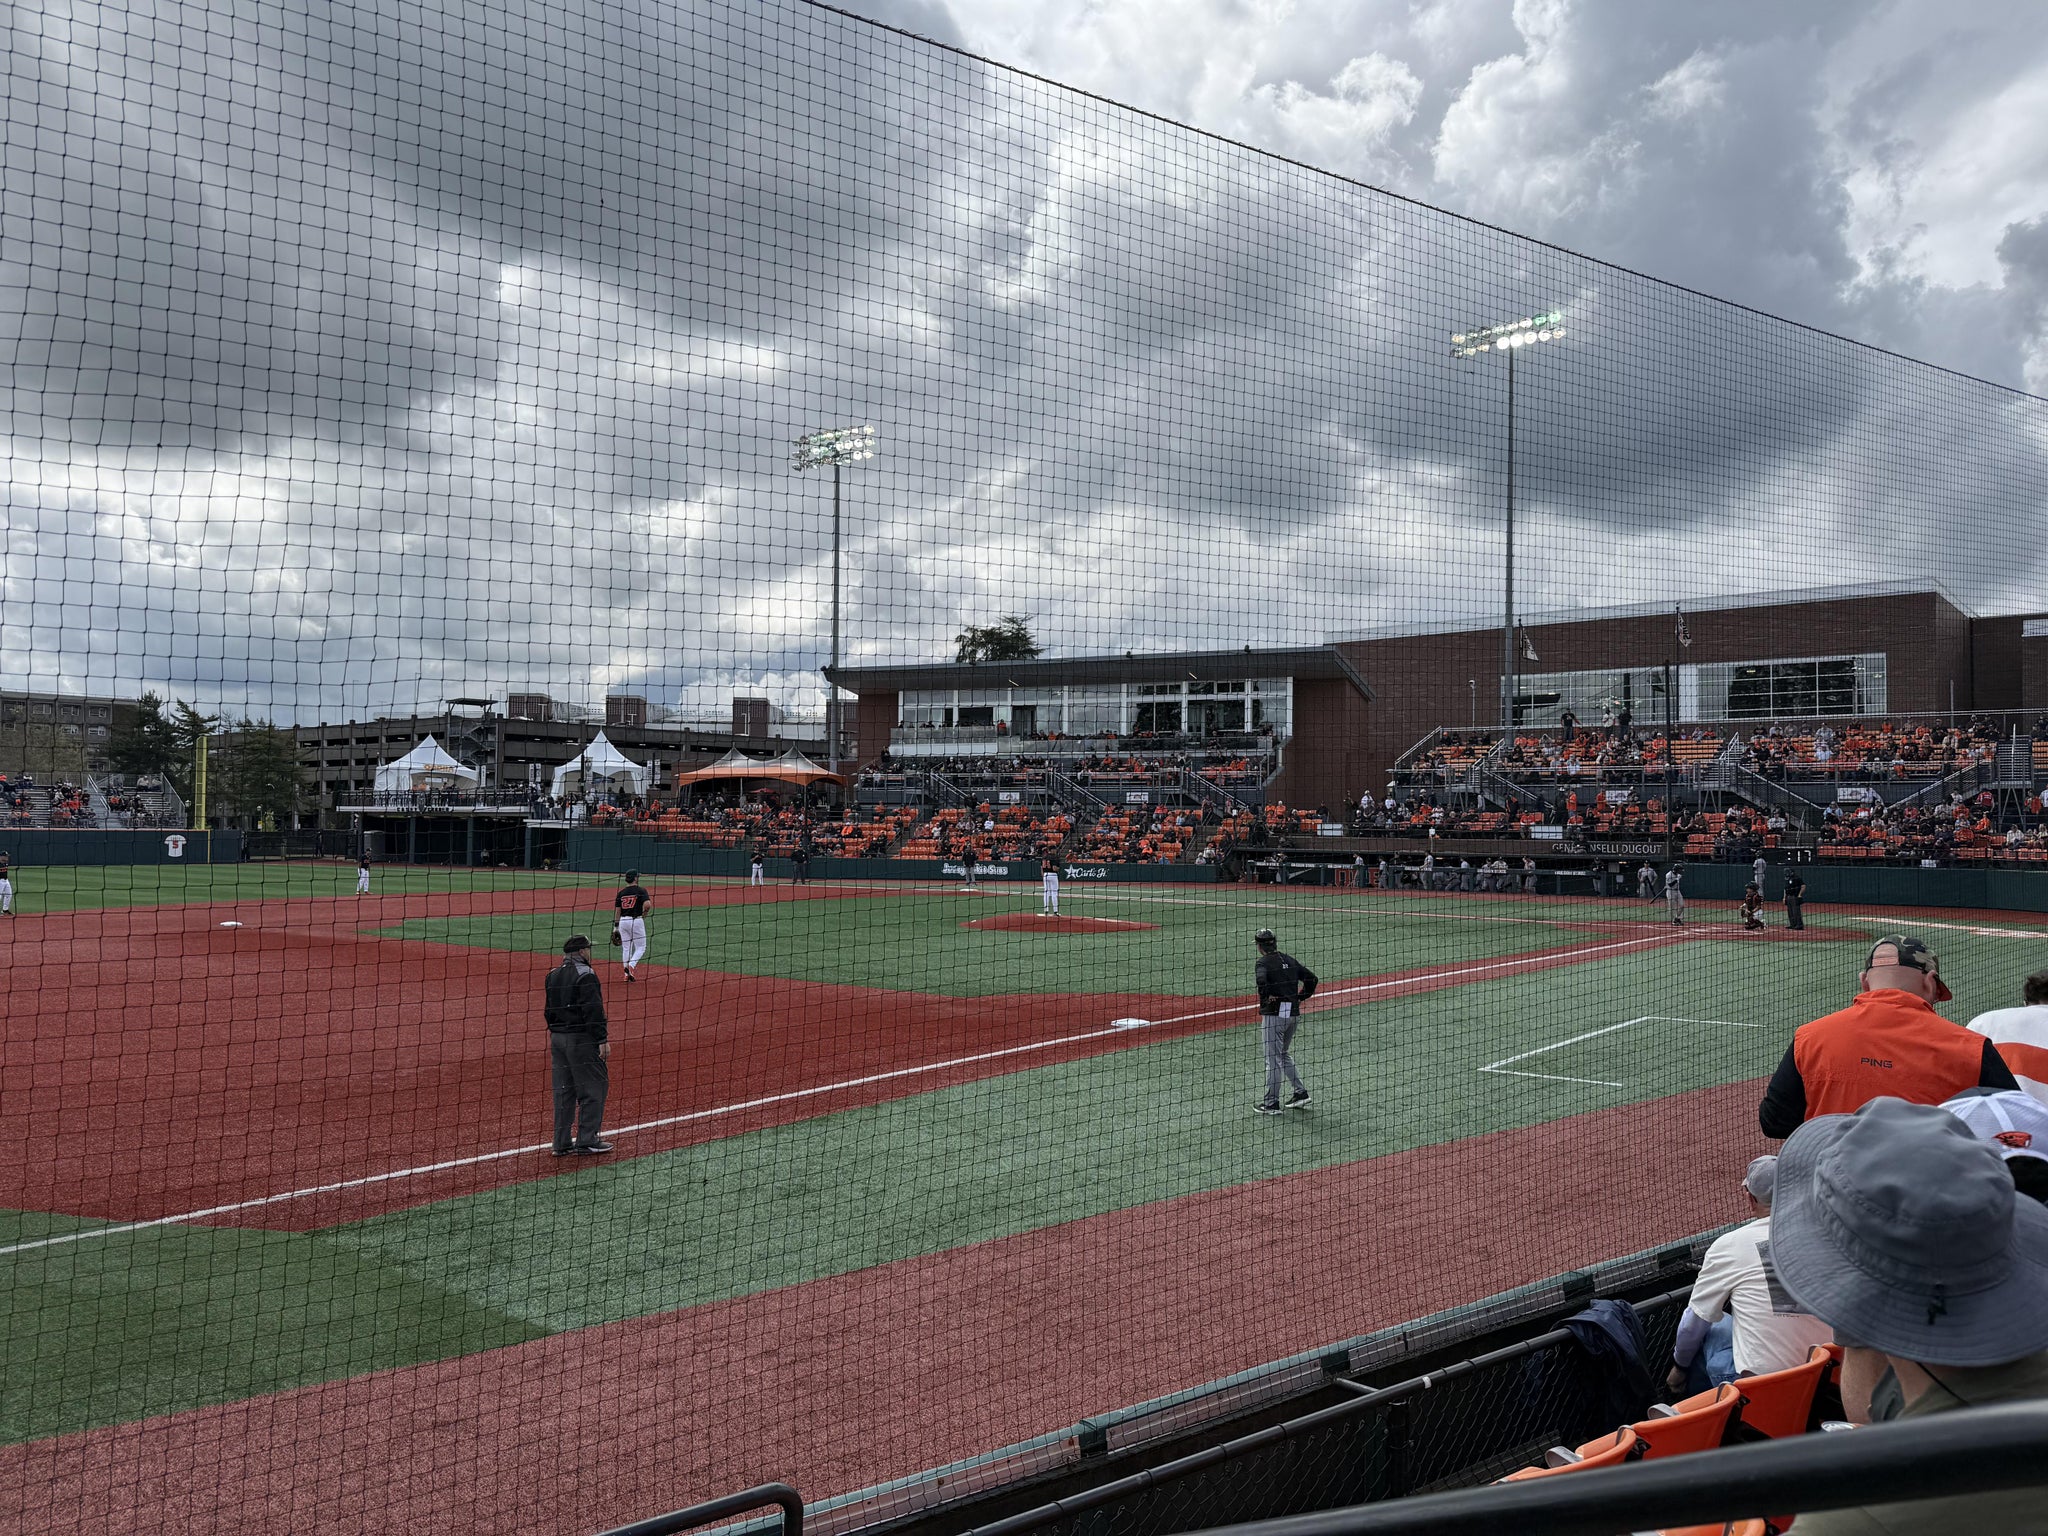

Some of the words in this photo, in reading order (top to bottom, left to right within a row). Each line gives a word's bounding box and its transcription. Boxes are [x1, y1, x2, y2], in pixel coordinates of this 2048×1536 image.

[1621, 844, 1662, 854] DUGOUT
[621, 895, 637, 909] 27
[1860, 1057, 1893, 1069] PING
